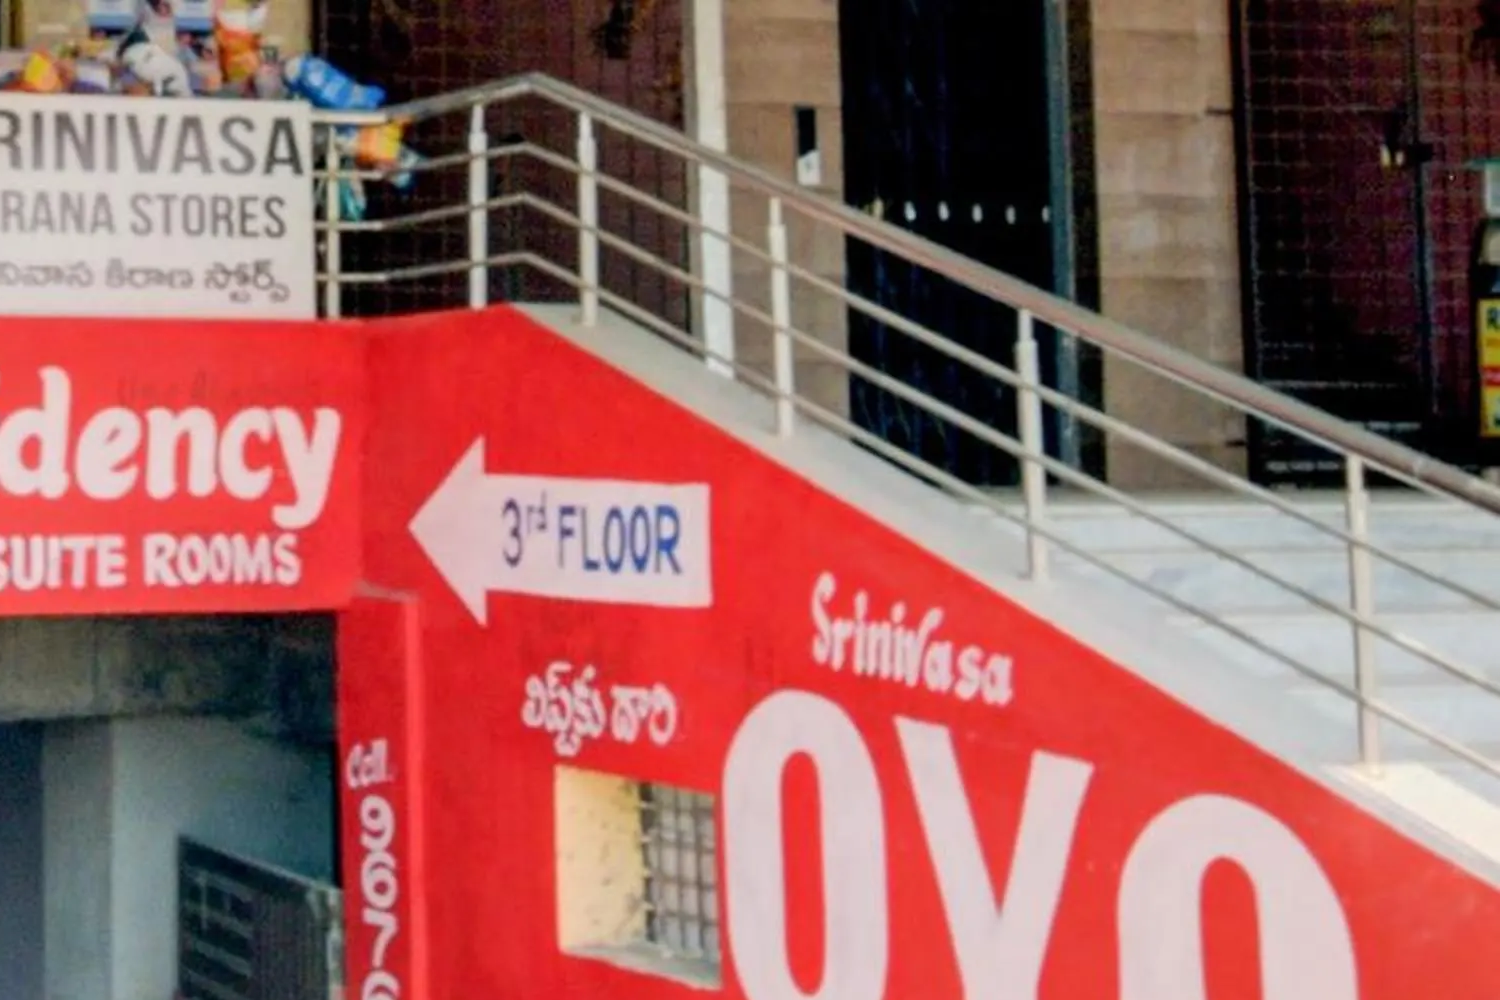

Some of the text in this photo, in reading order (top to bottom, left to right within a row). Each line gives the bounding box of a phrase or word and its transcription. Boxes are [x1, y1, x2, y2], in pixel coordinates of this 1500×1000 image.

[130, 193, 287, 241] STORES
[142, 532, 302, 588] ROOMS
[501, 490, 683, 575] 3rd FLOOR
[809, 572, 1014, 706] Srinivasa
